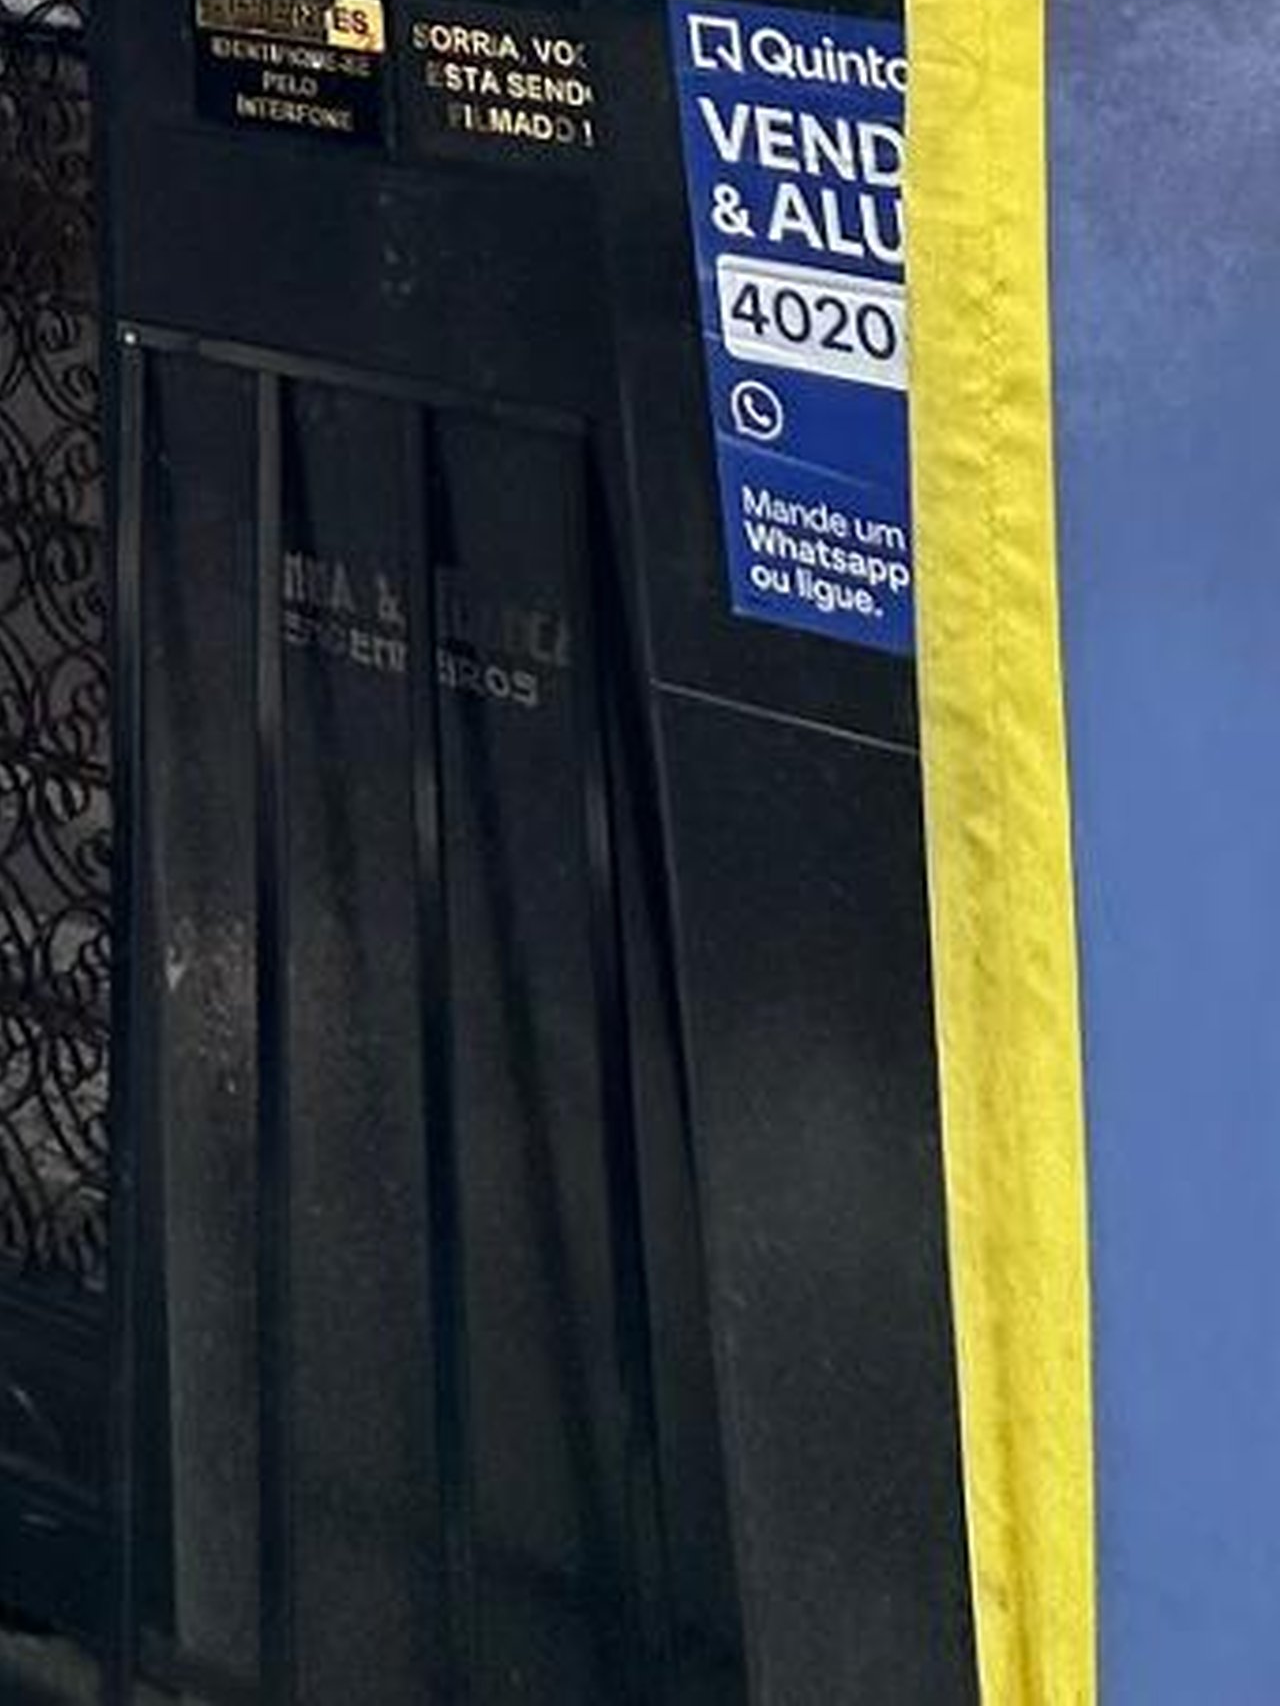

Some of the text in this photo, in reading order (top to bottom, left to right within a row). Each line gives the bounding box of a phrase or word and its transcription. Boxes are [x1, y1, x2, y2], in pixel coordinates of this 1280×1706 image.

[697, 96, 906, 188] VEND
[711, 182, 906, 263] & ALU
[730, 282, 898, 361] 4020
[742, 486, 907, 550] Mande um
[743, 520, 910, 594] Whatsapp
[751, 565, 885, 618] ou ligue.
